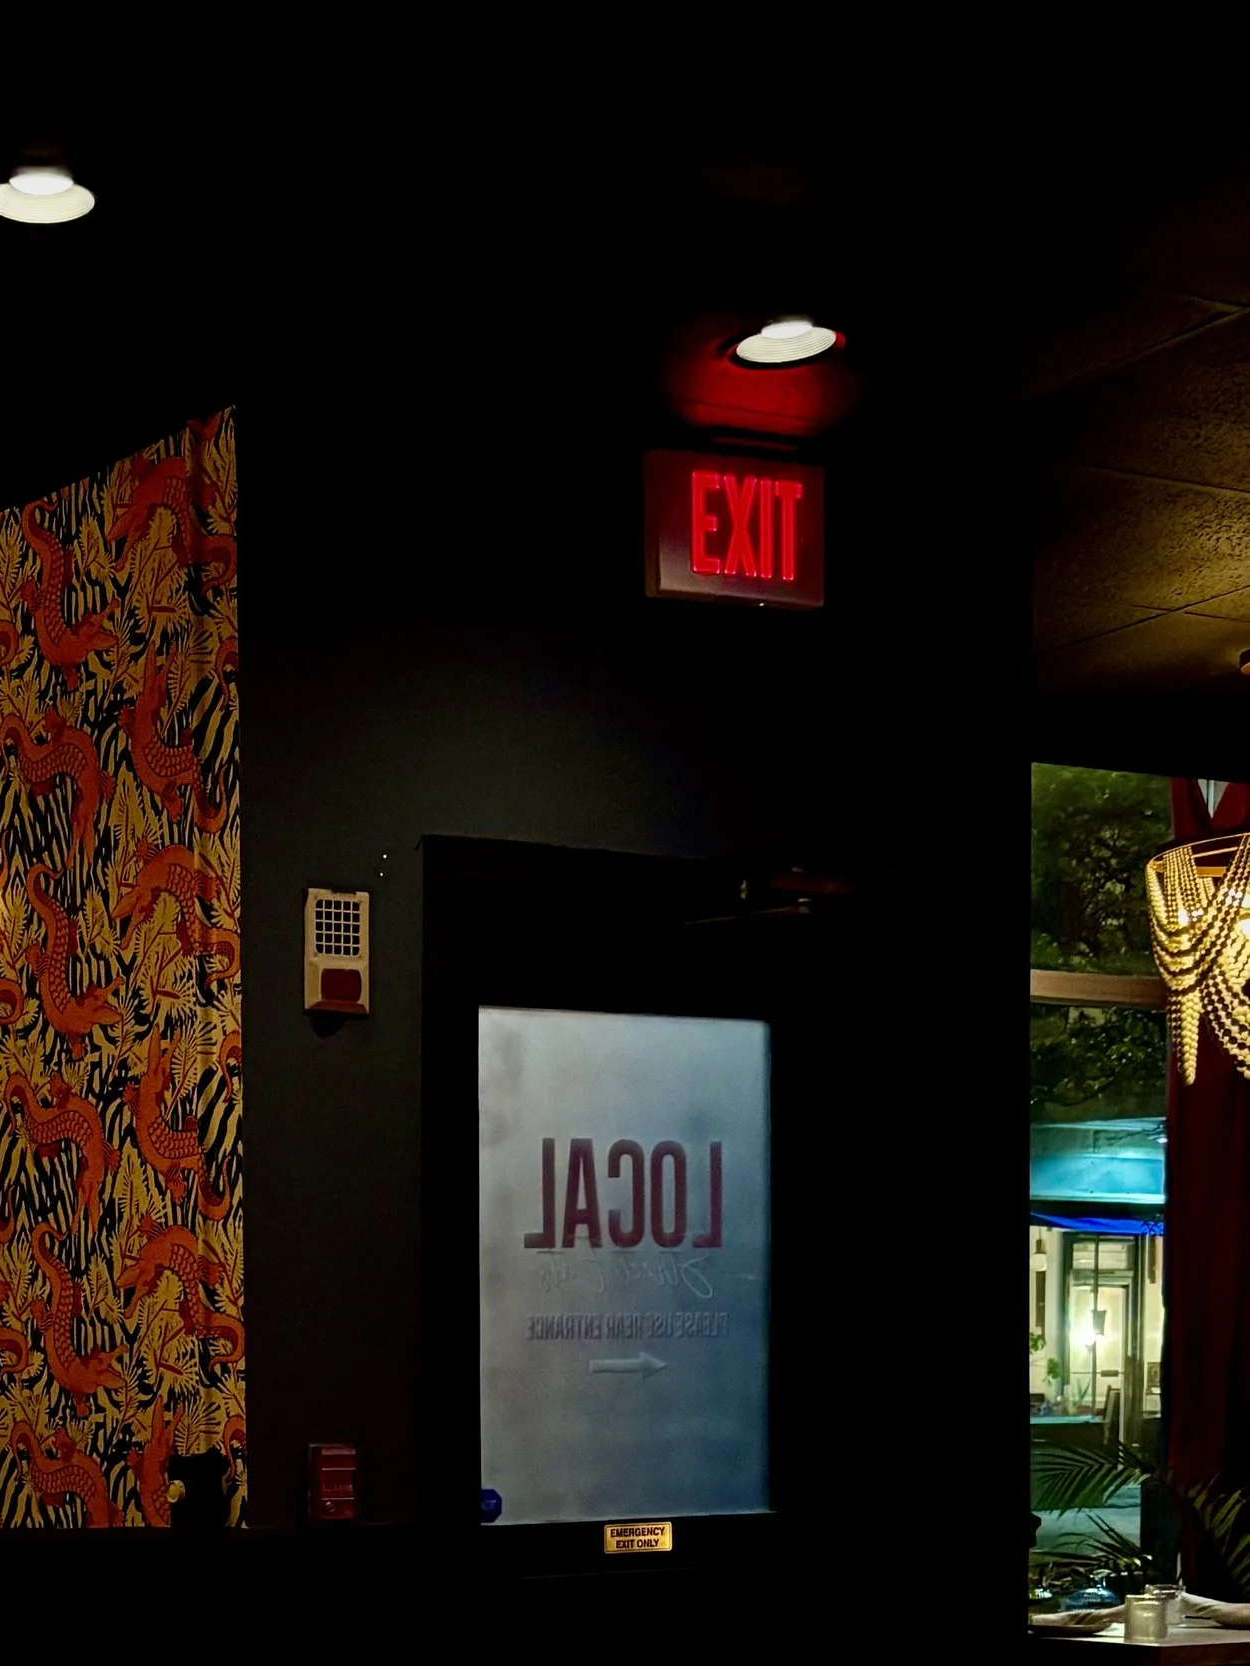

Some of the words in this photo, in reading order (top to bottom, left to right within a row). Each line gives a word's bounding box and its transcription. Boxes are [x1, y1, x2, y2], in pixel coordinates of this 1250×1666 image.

[691, 470, 803, 581] EXIT
[610, 1526, 666, 1538] EMERGENCY
[616, 1539, 634, 1549] EXIT
[636, 1539, 660, 1548] ONLY
